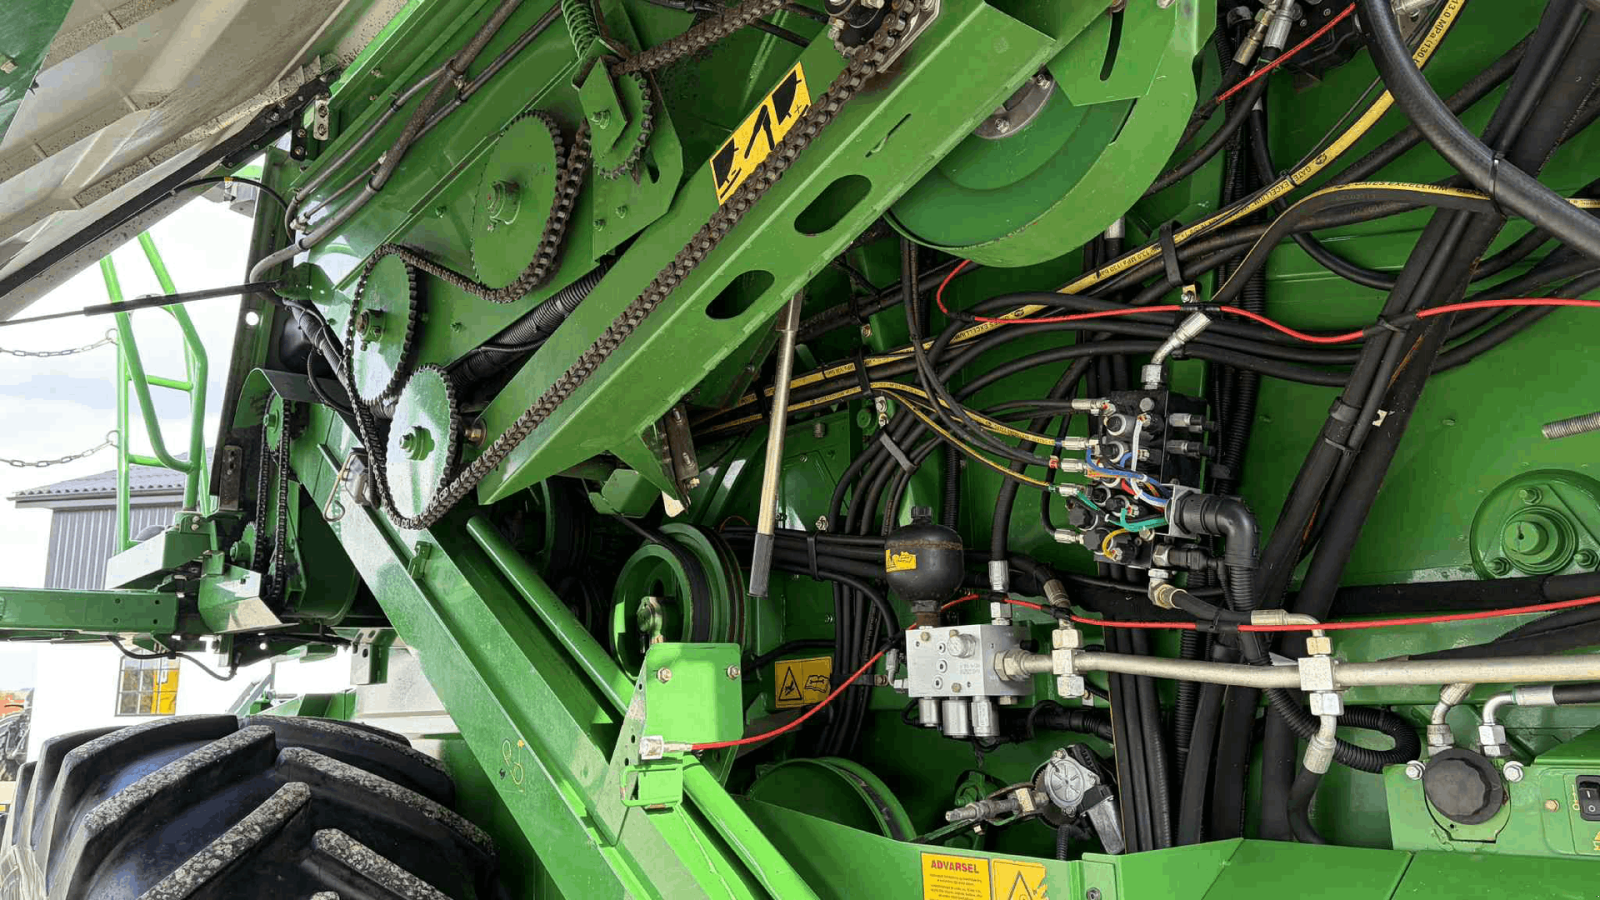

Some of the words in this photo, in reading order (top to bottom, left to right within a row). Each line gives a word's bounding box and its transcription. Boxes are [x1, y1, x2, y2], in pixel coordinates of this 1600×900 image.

[1429, 18, 1446, 39] MPa
[1292, 165, 1311, 181] GATE
[931, 860, 979, 873] ADVARSEL
